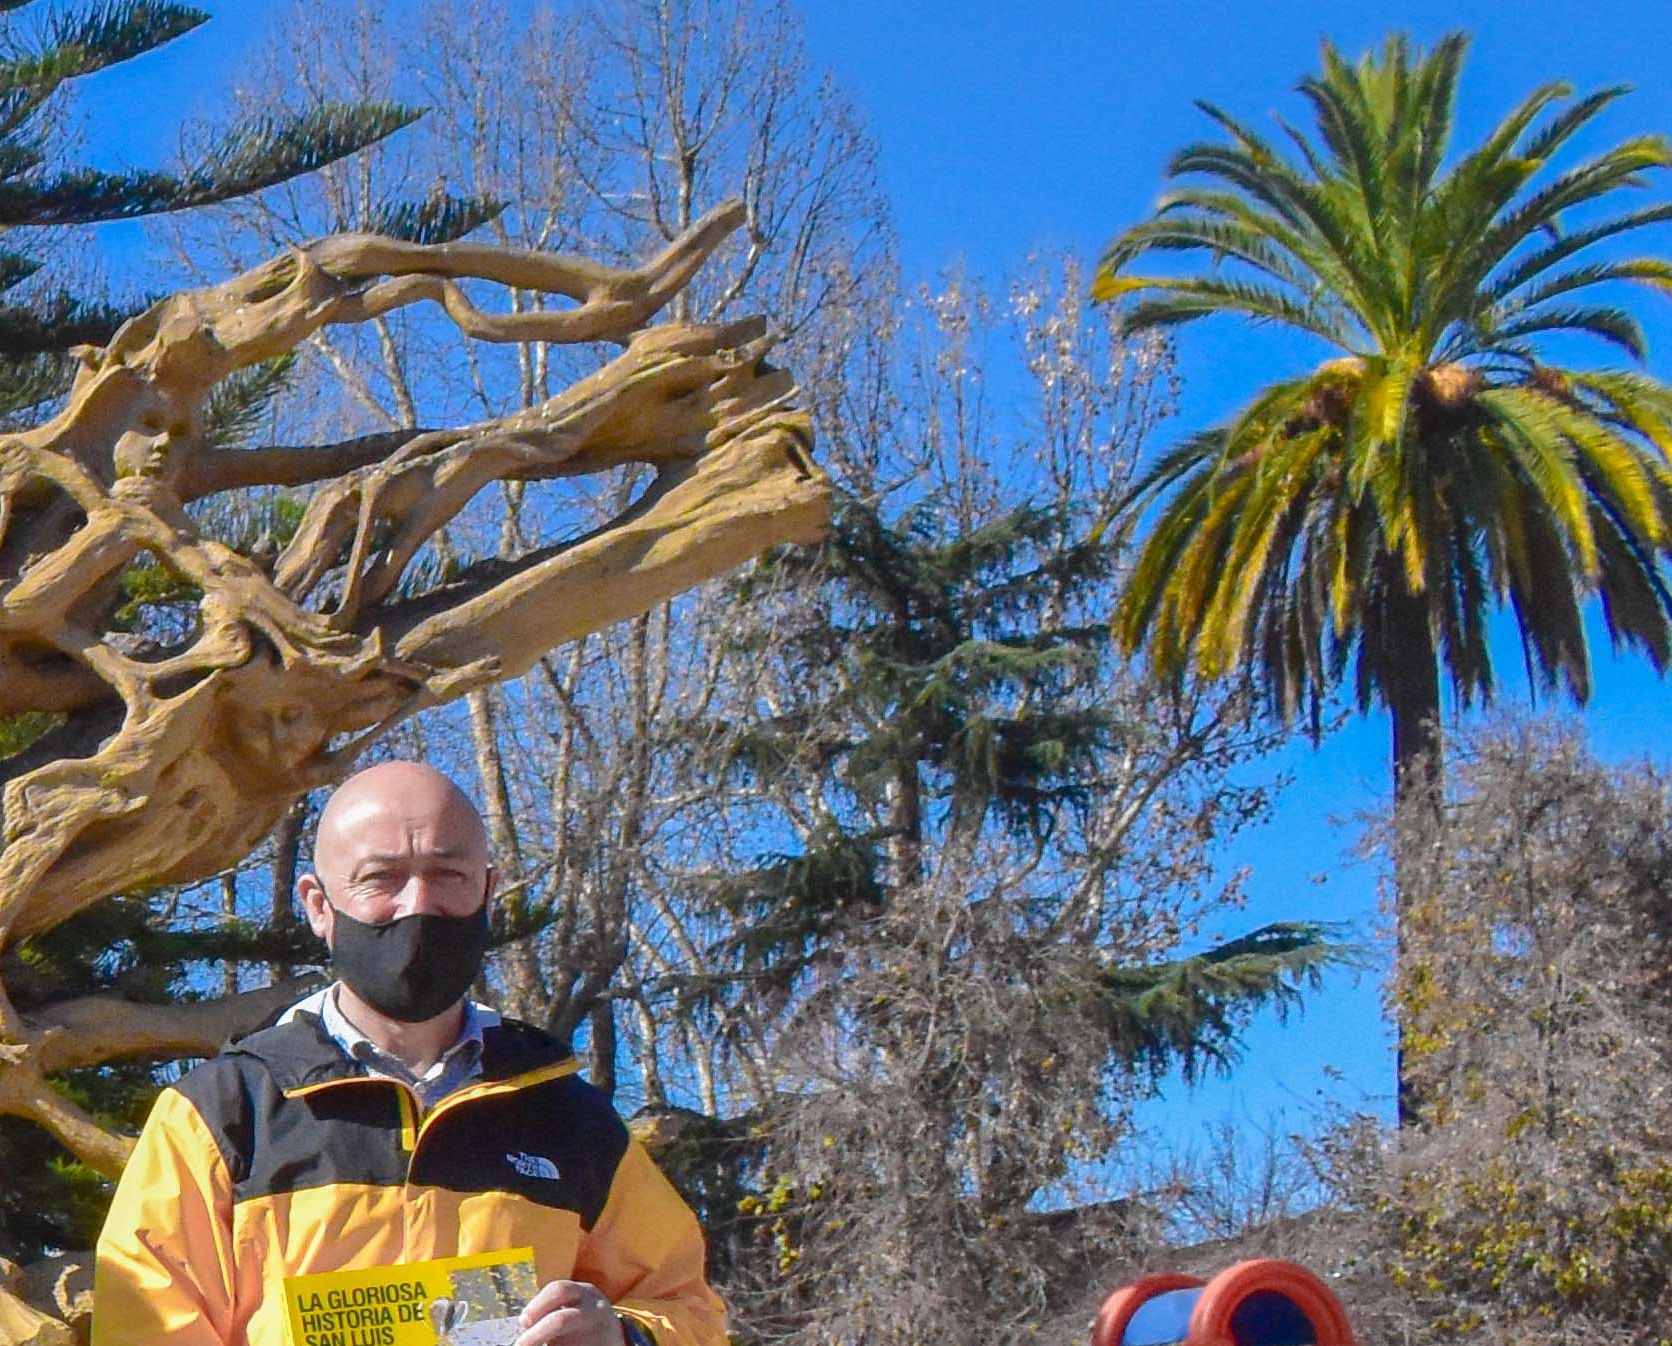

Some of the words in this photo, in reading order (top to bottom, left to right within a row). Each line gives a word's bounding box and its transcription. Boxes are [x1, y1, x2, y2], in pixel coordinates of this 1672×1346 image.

[297, 1292, 323, 1313] LA
[328, 1281, 428, 1309] GLORIOSA
[303, 1304, 394, 1334] HISTORIA
[399, 1302, 425, 1323] DE
